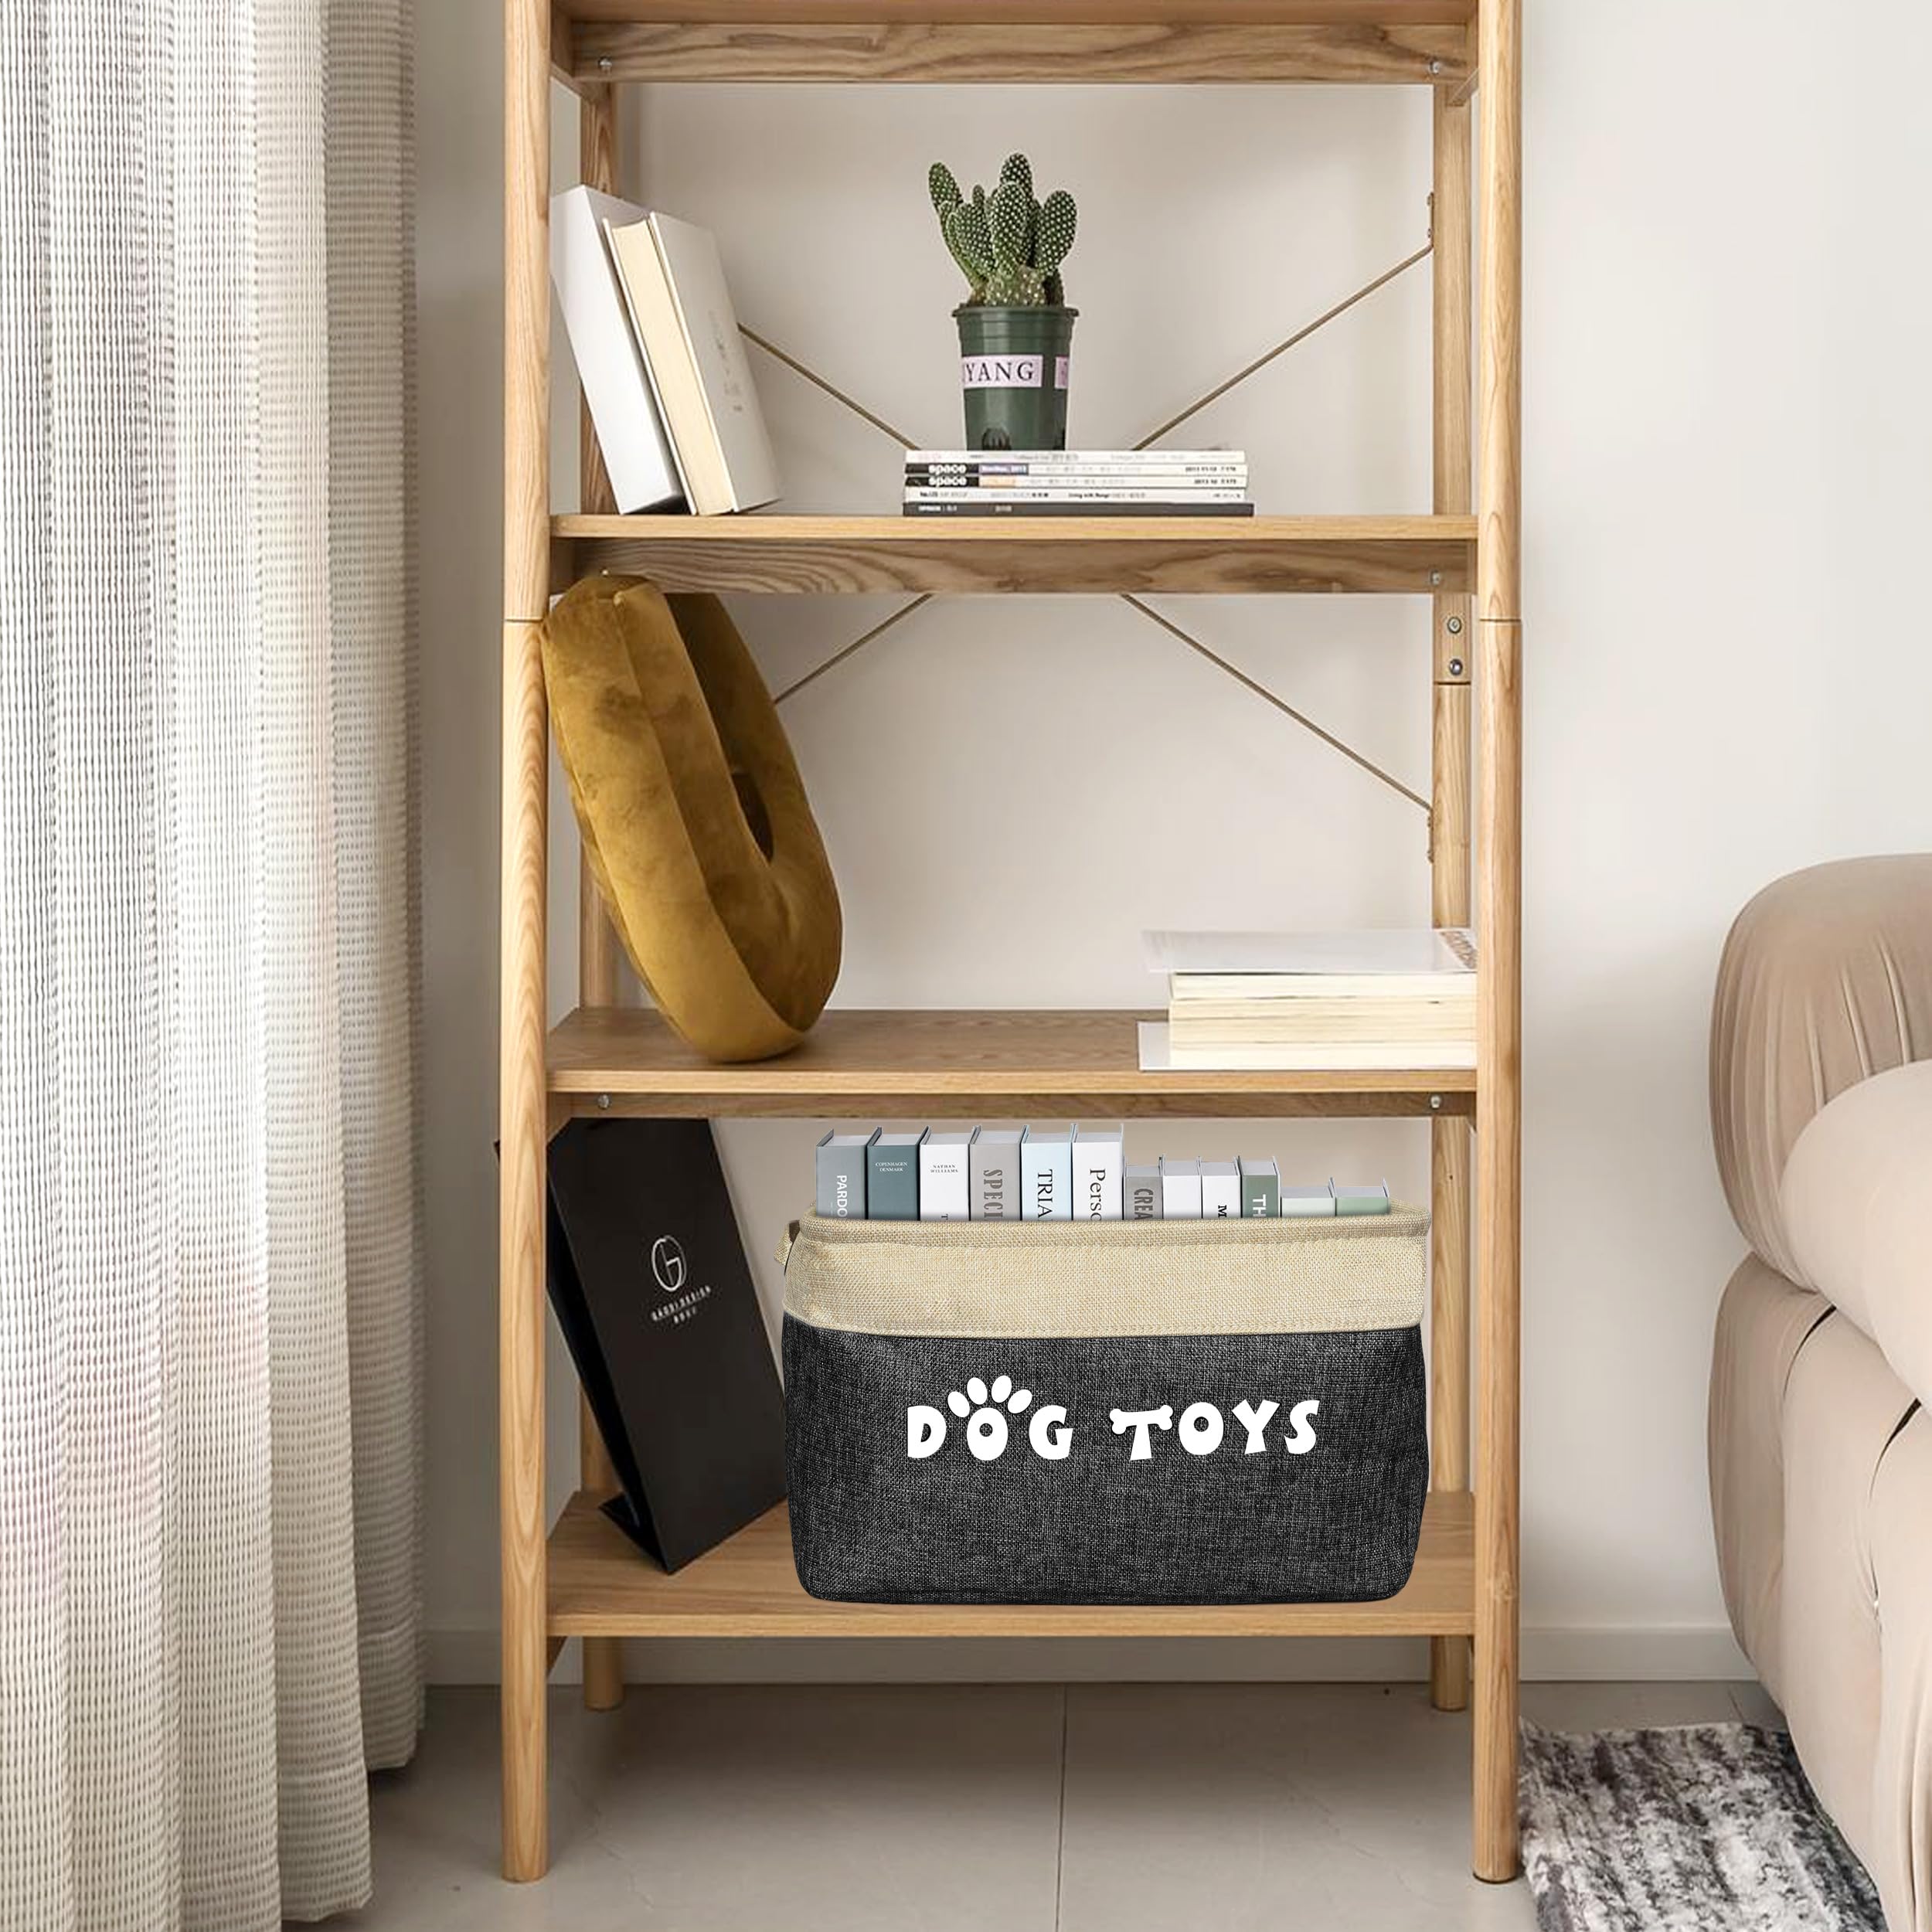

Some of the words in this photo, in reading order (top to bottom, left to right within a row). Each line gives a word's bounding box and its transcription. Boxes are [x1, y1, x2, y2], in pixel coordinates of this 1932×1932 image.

[962, 361, 1034, 382] YANG
[836, 1175, 848, 1217] PARDO
[1037, 1168, 1053, 1221] TRIA
[907, 1375, 1073, 1461] DOG
[1109, 1400, 1320, 1461] TOYS
